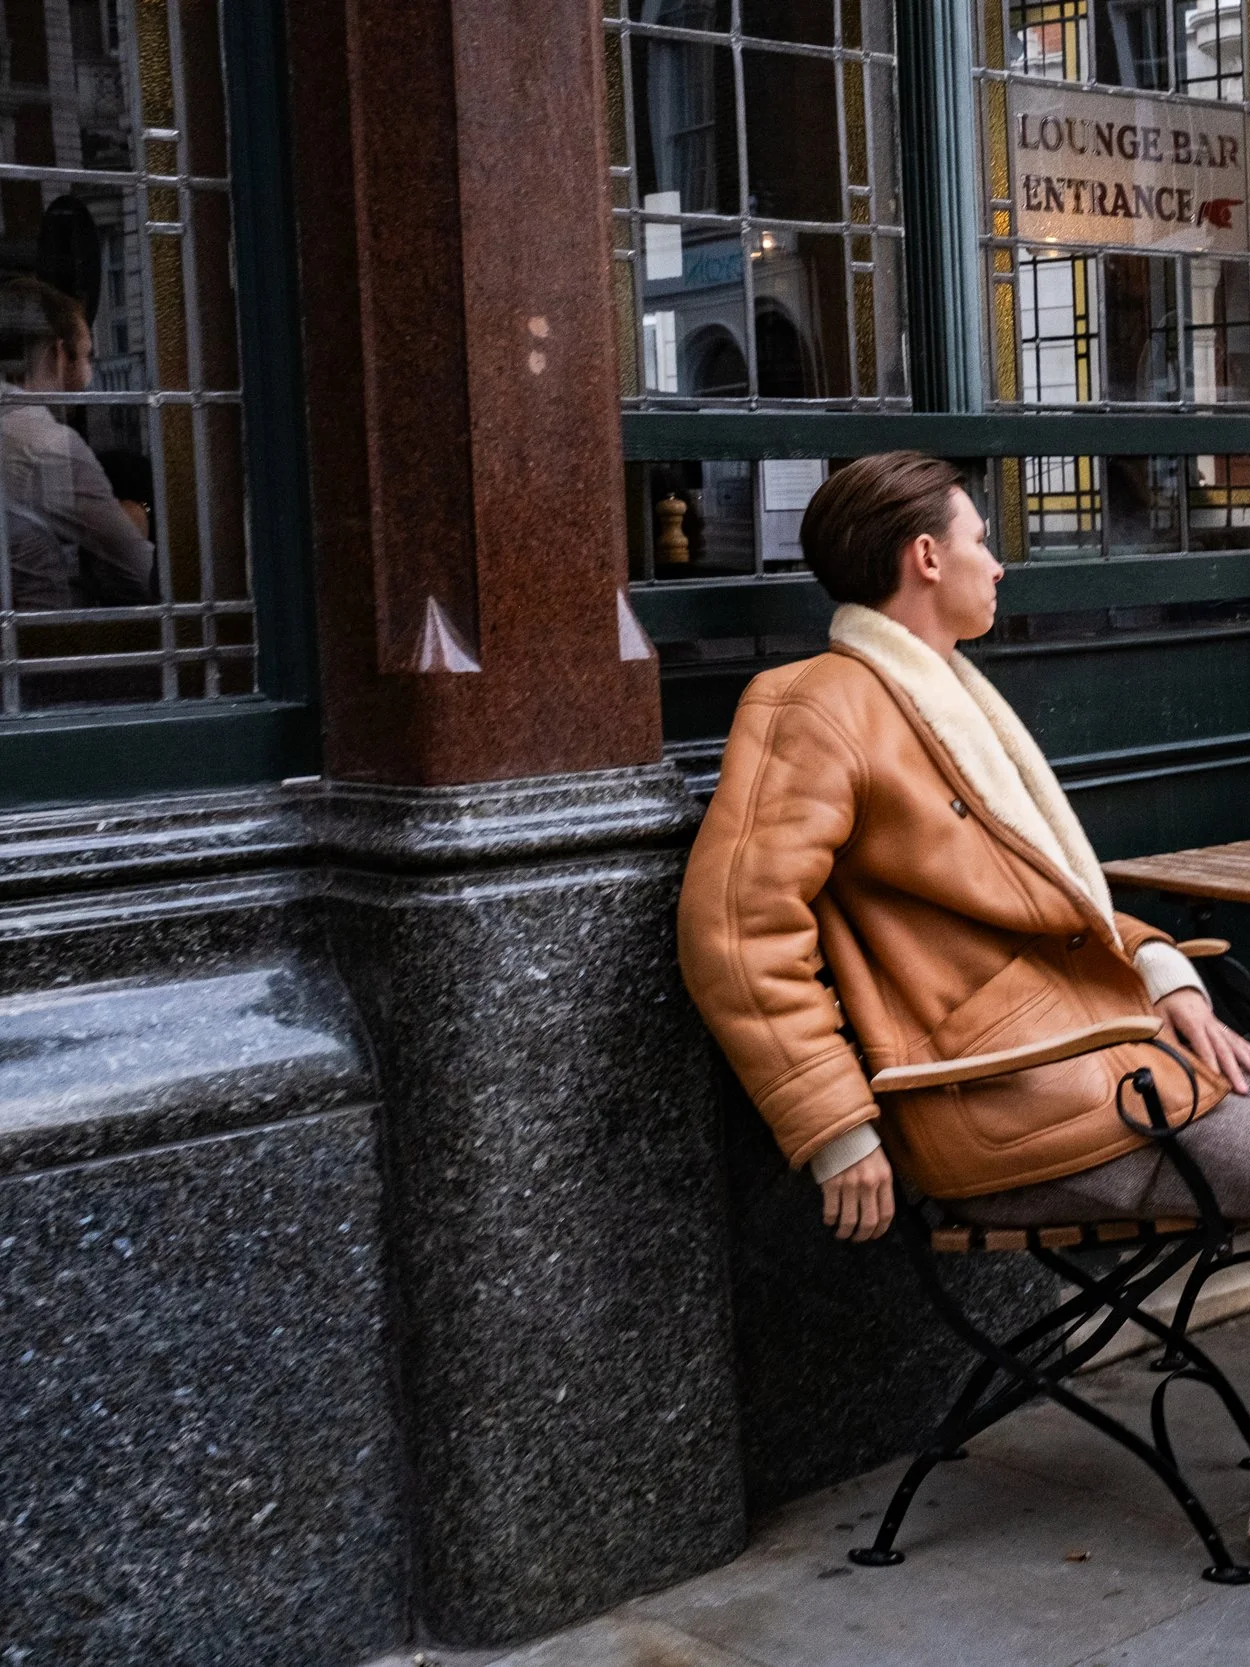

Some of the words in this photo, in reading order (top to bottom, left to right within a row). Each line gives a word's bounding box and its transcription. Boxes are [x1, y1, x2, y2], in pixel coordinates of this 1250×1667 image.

[1017, 113, 1162, 163] LOUNGE
[1172, 130, 1241, 168] BAR
[1021, 174, 1195, 224] ENTRANCE
